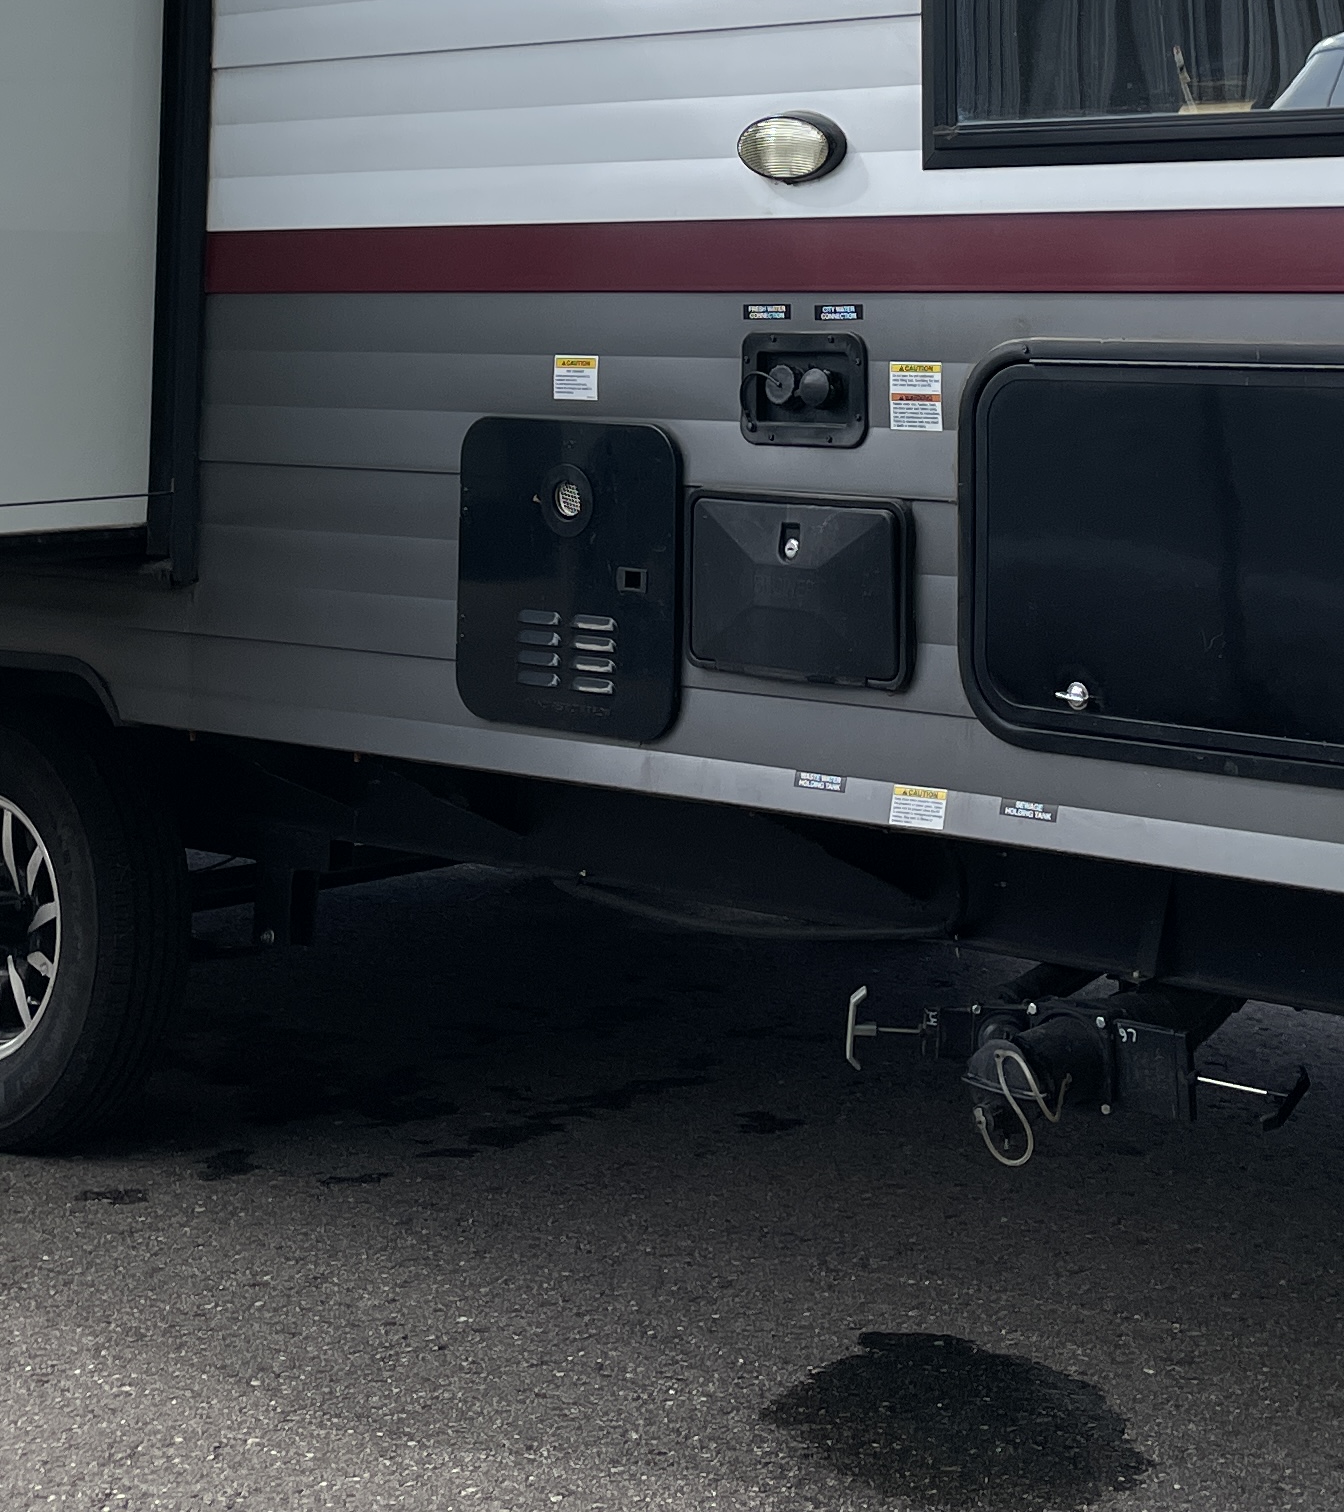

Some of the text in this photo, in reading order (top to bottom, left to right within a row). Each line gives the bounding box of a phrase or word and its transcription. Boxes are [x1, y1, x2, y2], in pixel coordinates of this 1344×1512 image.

[798, 779, 841, 791] HOLDING TANK
[908, 789, 939, 799] CAUTION
[1005, 806, 1052, 821] HOLDING TANK
